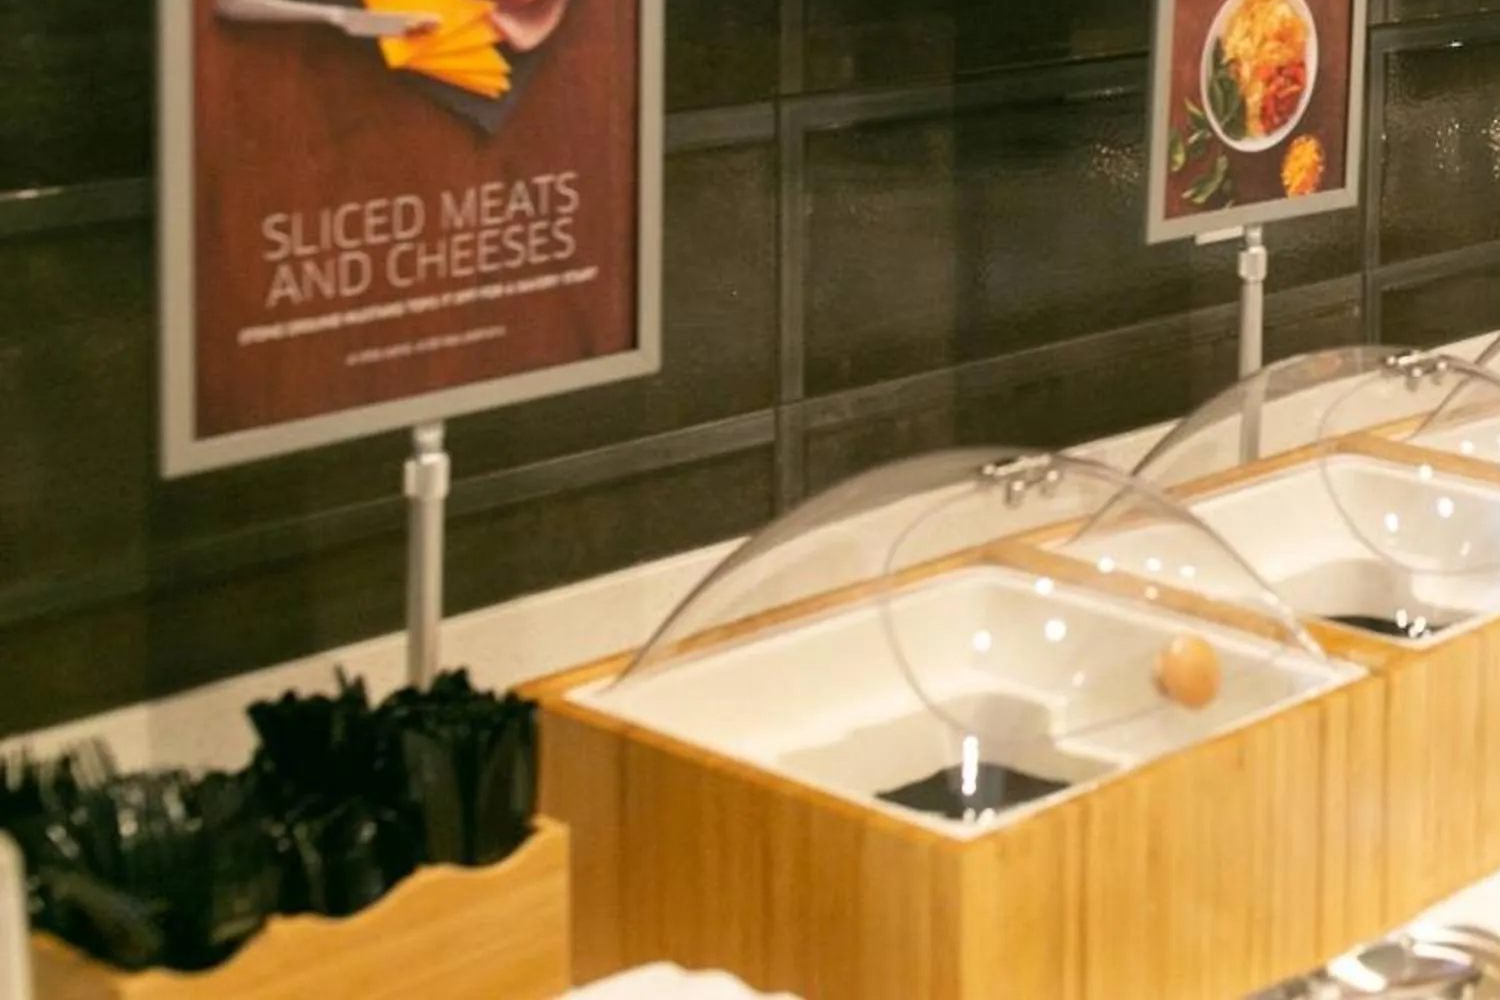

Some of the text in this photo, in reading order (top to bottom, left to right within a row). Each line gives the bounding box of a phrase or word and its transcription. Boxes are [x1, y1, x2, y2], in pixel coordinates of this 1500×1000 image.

[262, 171, 580, 262] SLICED MEATS
[266, 251, 372, 308] AND
[386, 216, 577, 288] CHEESES
